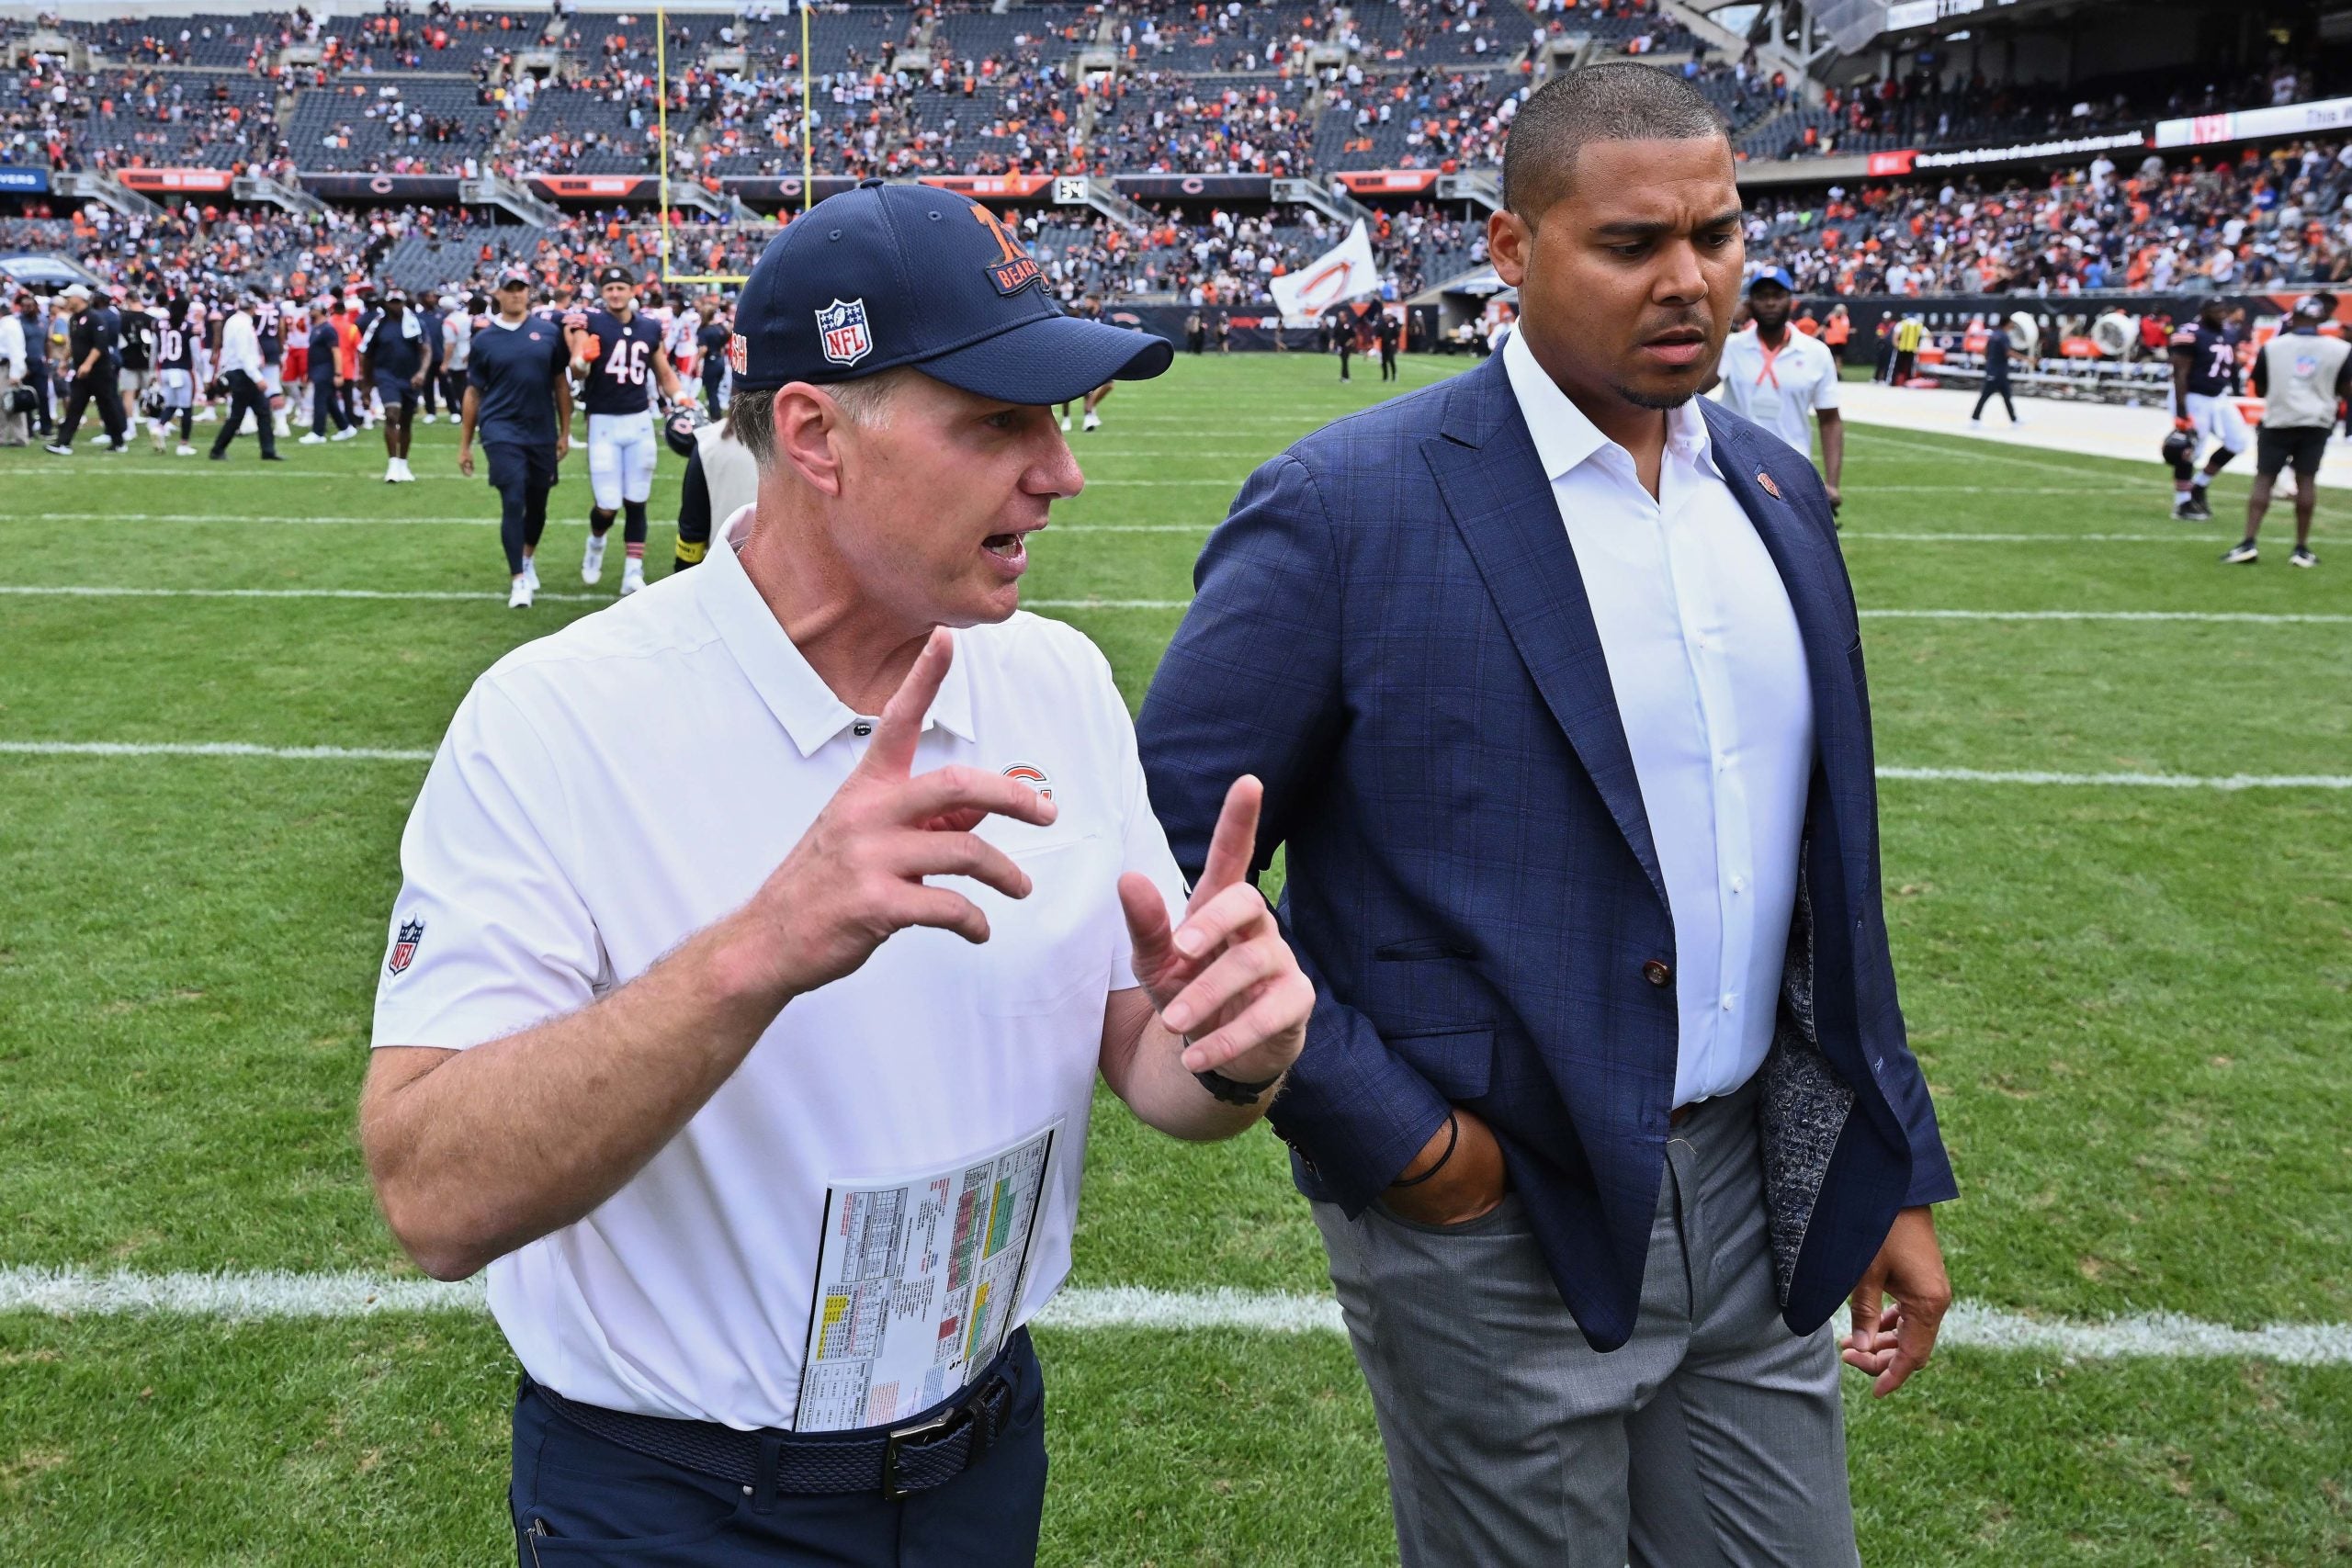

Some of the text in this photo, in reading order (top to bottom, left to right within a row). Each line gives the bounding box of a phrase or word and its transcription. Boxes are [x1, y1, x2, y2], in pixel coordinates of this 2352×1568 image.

[997, 259, 1038, 288] BEARS
[827, 327, 865, 356] NFL
[605, 339, 650, 385] 46
[391, 943, 413, 969] NFL
